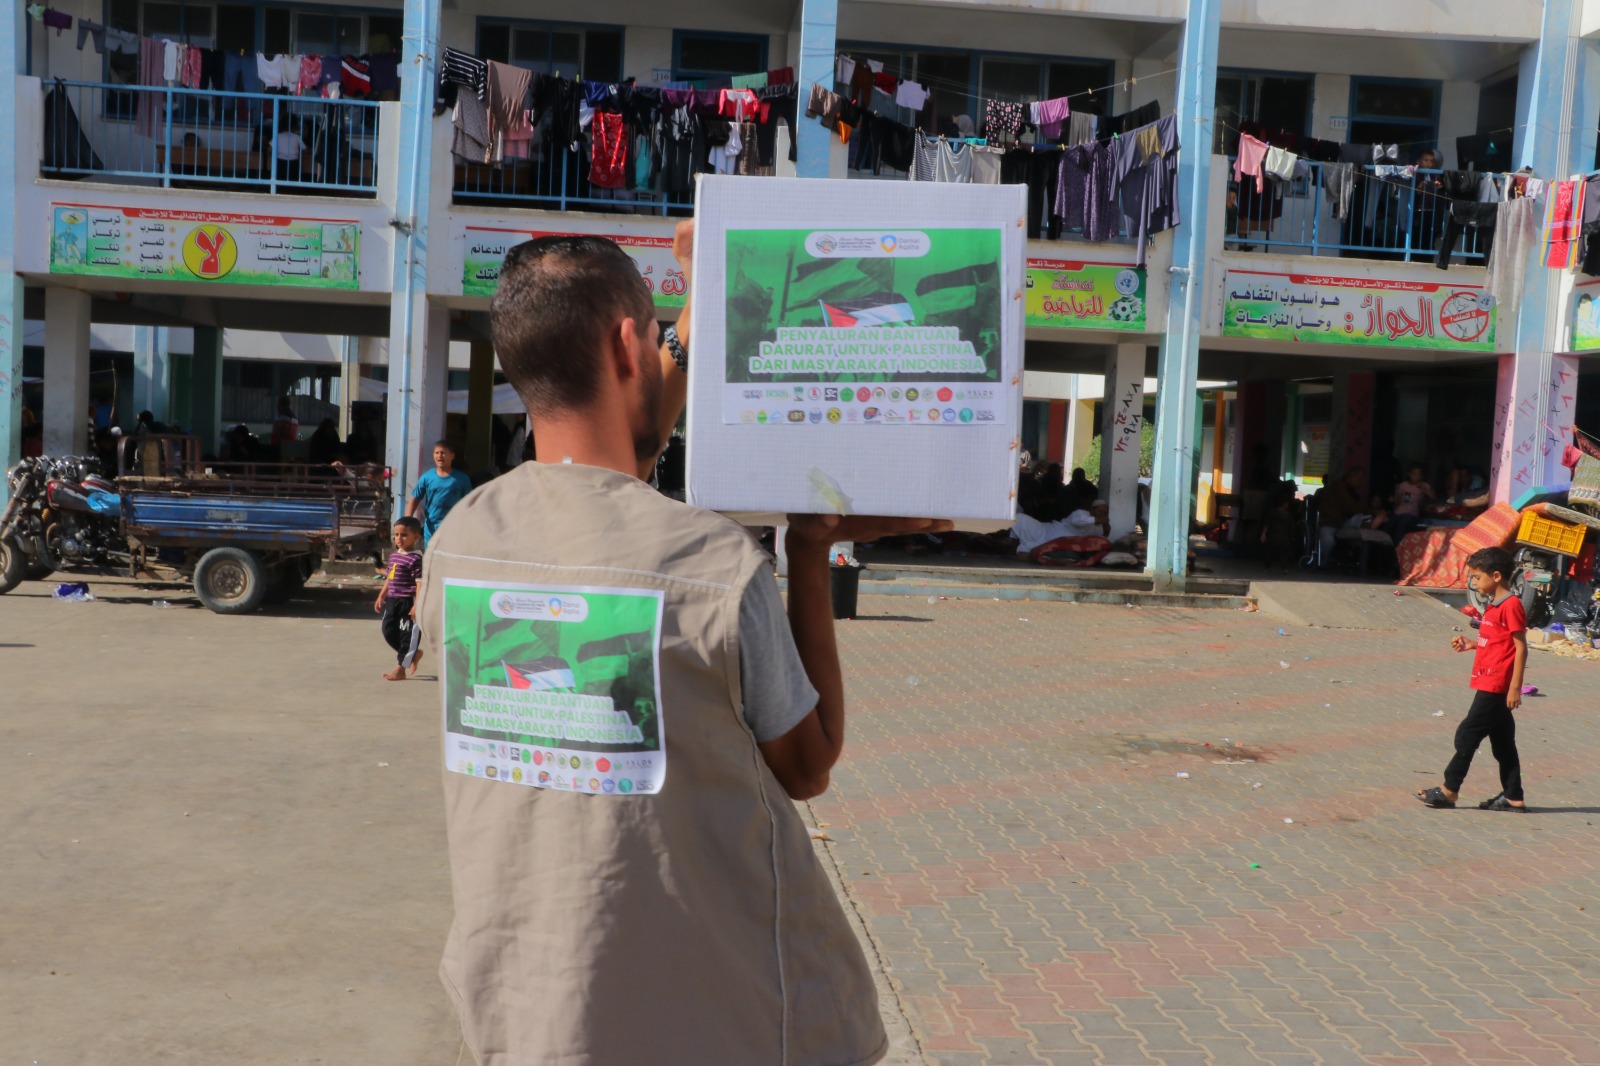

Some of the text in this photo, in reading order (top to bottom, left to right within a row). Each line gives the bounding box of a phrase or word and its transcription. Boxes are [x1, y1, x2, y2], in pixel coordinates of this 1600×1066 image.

[779, 329, 957, 342] PENYALURAN BANTUAN
[762, 343, 973, 356] DARURAT UNTUK PALESTINA
[751, 358, 984, 371] DARI MASYARAKAT INDONESIA
[475, 688, 611, 711] PENYALURAN BANTUAN
[466, 699, 630, 726] DARURAT UNTUK PALESTINA
[462, 714, 641, 741] DARI MASYARAKAT INDONESIA
